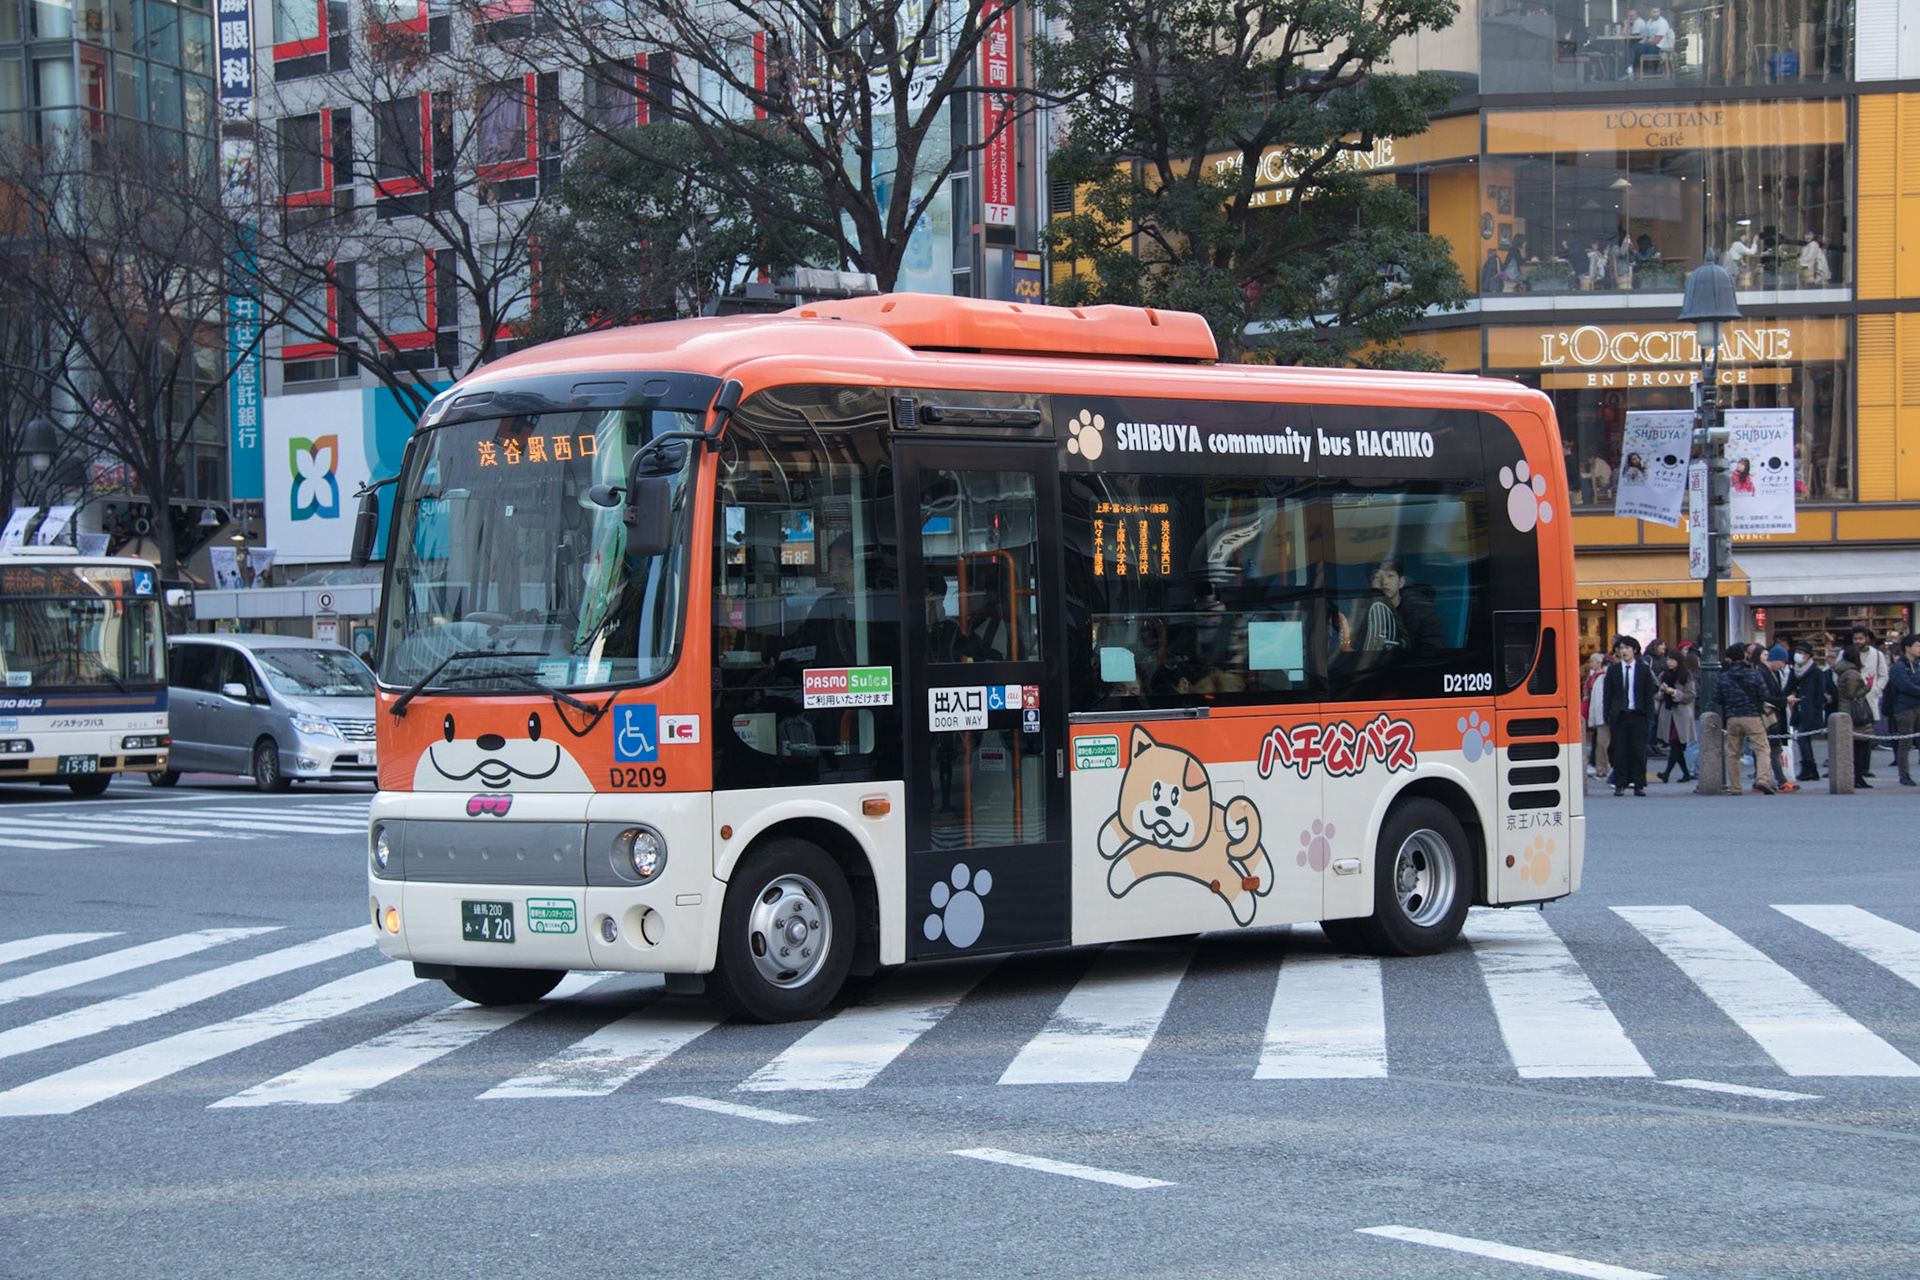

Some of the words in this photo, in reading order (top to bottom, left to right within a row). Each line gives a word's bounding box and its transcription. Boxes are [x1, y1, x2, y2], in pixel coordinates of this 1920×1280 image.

[226, 101, 249, 117] 5F
[1605, 110, 1725, 129] L'OCCITANE
[1645, 132, 1684, 147] Café
[990, 206, 1008, 222] 7F
[1015, 278, 1040, 297] パスタ
[1540, 325, 1792, 366] L'OCCITANE
[1587, 373, 1614, 386] EN
[1628, 371, 1747, 386] PROVECE
[1116, 422, 1203, 452] SHIBUYA
[1207, 426, 1311, 462] community
[1317, 428, 1351, 456] bus
[1355, 430, 1434, 458] HACHIKO
[1635, 429, 1681, 441] SHIBUYA
[1735, 429, 1782, 442] SHIBUYA
[478, 434, 597, 466] 渋谷駅西口
[1691, 472, 1702, 568] 道玄坂
[1600, 588, 1661, 598] L'OCCITANE
[806, 675, 847, 689] PASMO
[851, 674, 888, 687] Suica
[1443, 672, 1492, 693] D21209
[17, 699, 43, 708] BUS
[806, 693, 889, 706] ご利用いただけます
[934, 690, 982, 713] 出入口
[50, 719, 104, 728] ノンステップバス
[935, 717, 959, 728] DOOR
[965, 715, 982, 726] WAY
[1258, 712, 1417, 779] ハチ公バス
[609, 767, 667, 788] D209
[1506, 811, 1563, 831] 京王バス東
[473, 904, 488, 915] 練馬
[488, 904, 503, 916] 200
